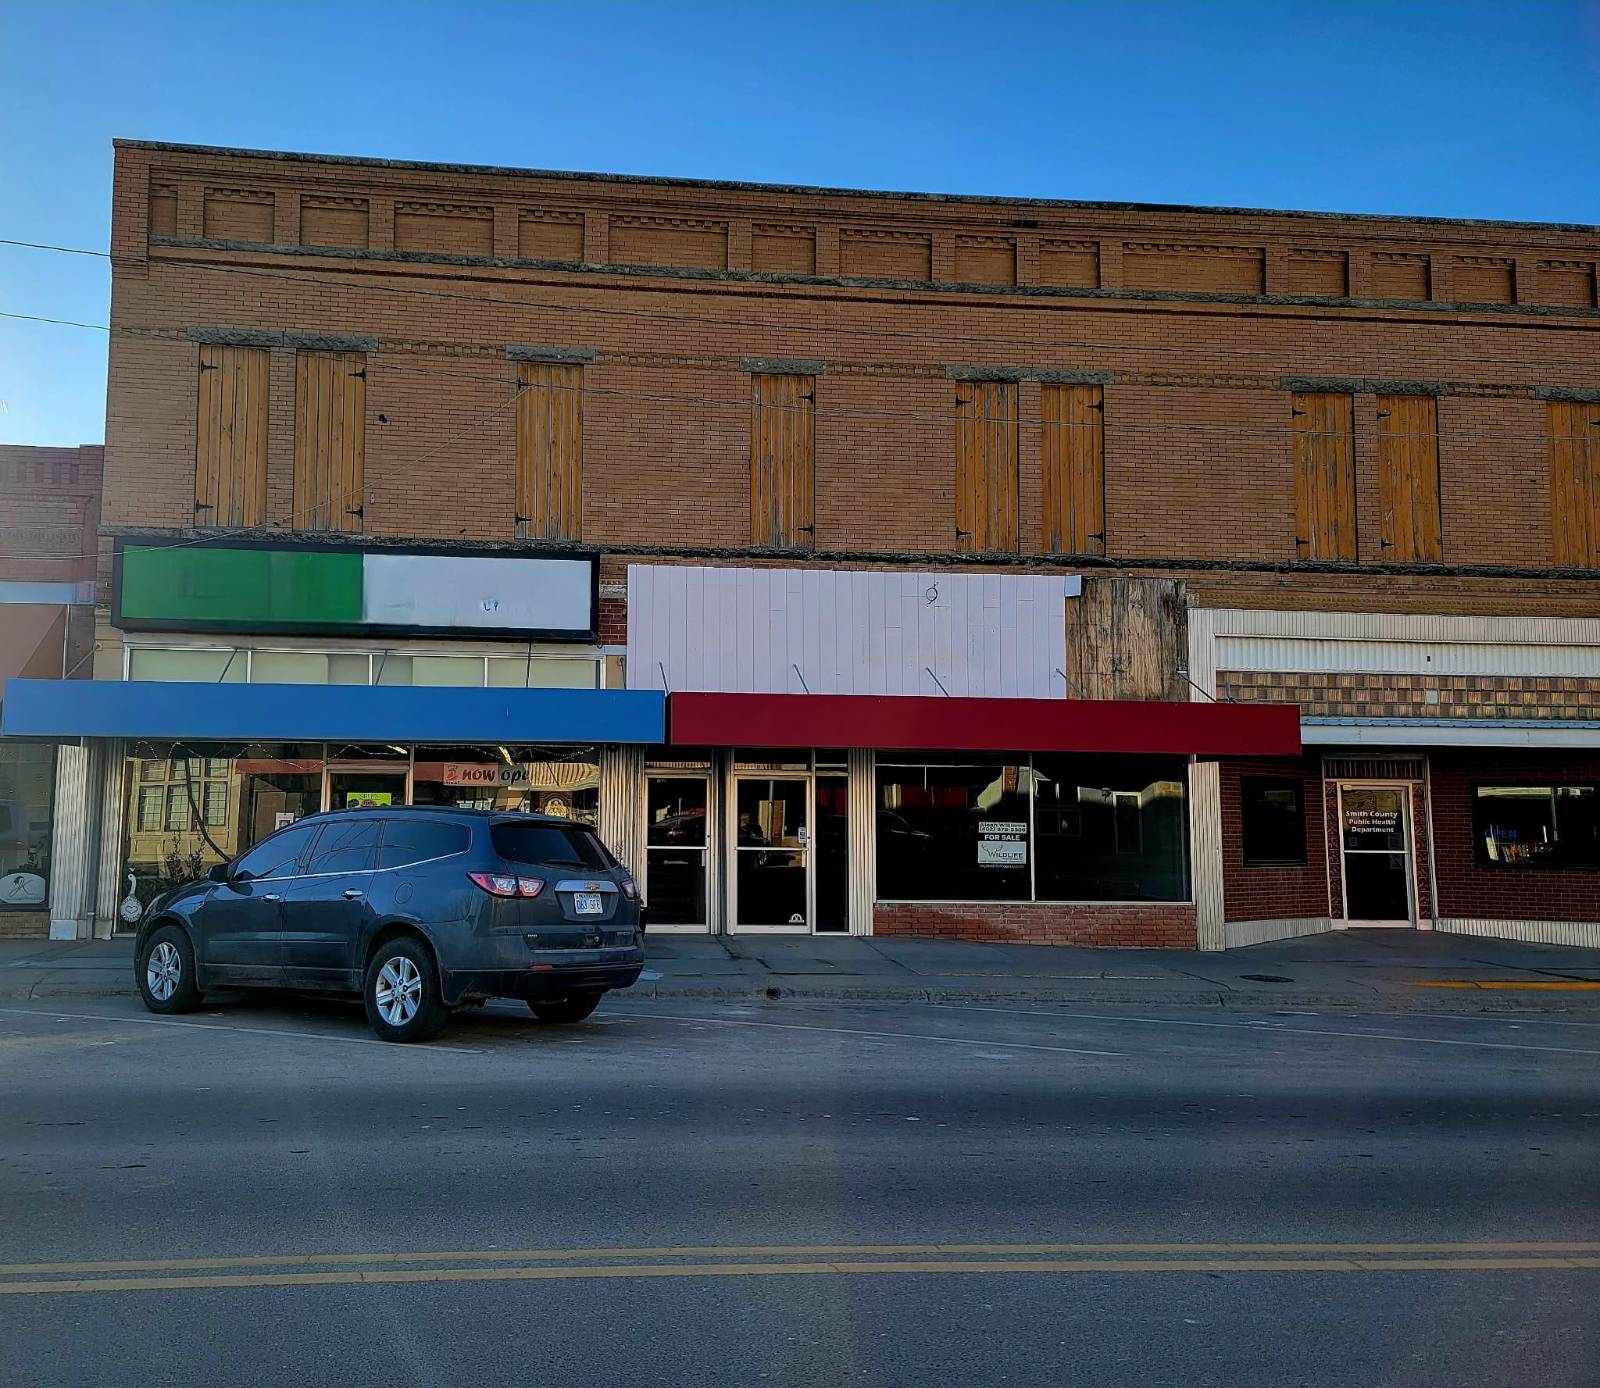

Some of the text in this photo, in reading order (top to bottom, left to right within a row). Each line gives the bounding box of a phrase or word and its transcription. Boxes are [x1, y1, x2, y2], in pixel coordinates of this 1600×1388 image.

[462, 769, 496, 782] now
[1369, 810, 1398, 819] County
[1351, 826, 1395, 834] Department
